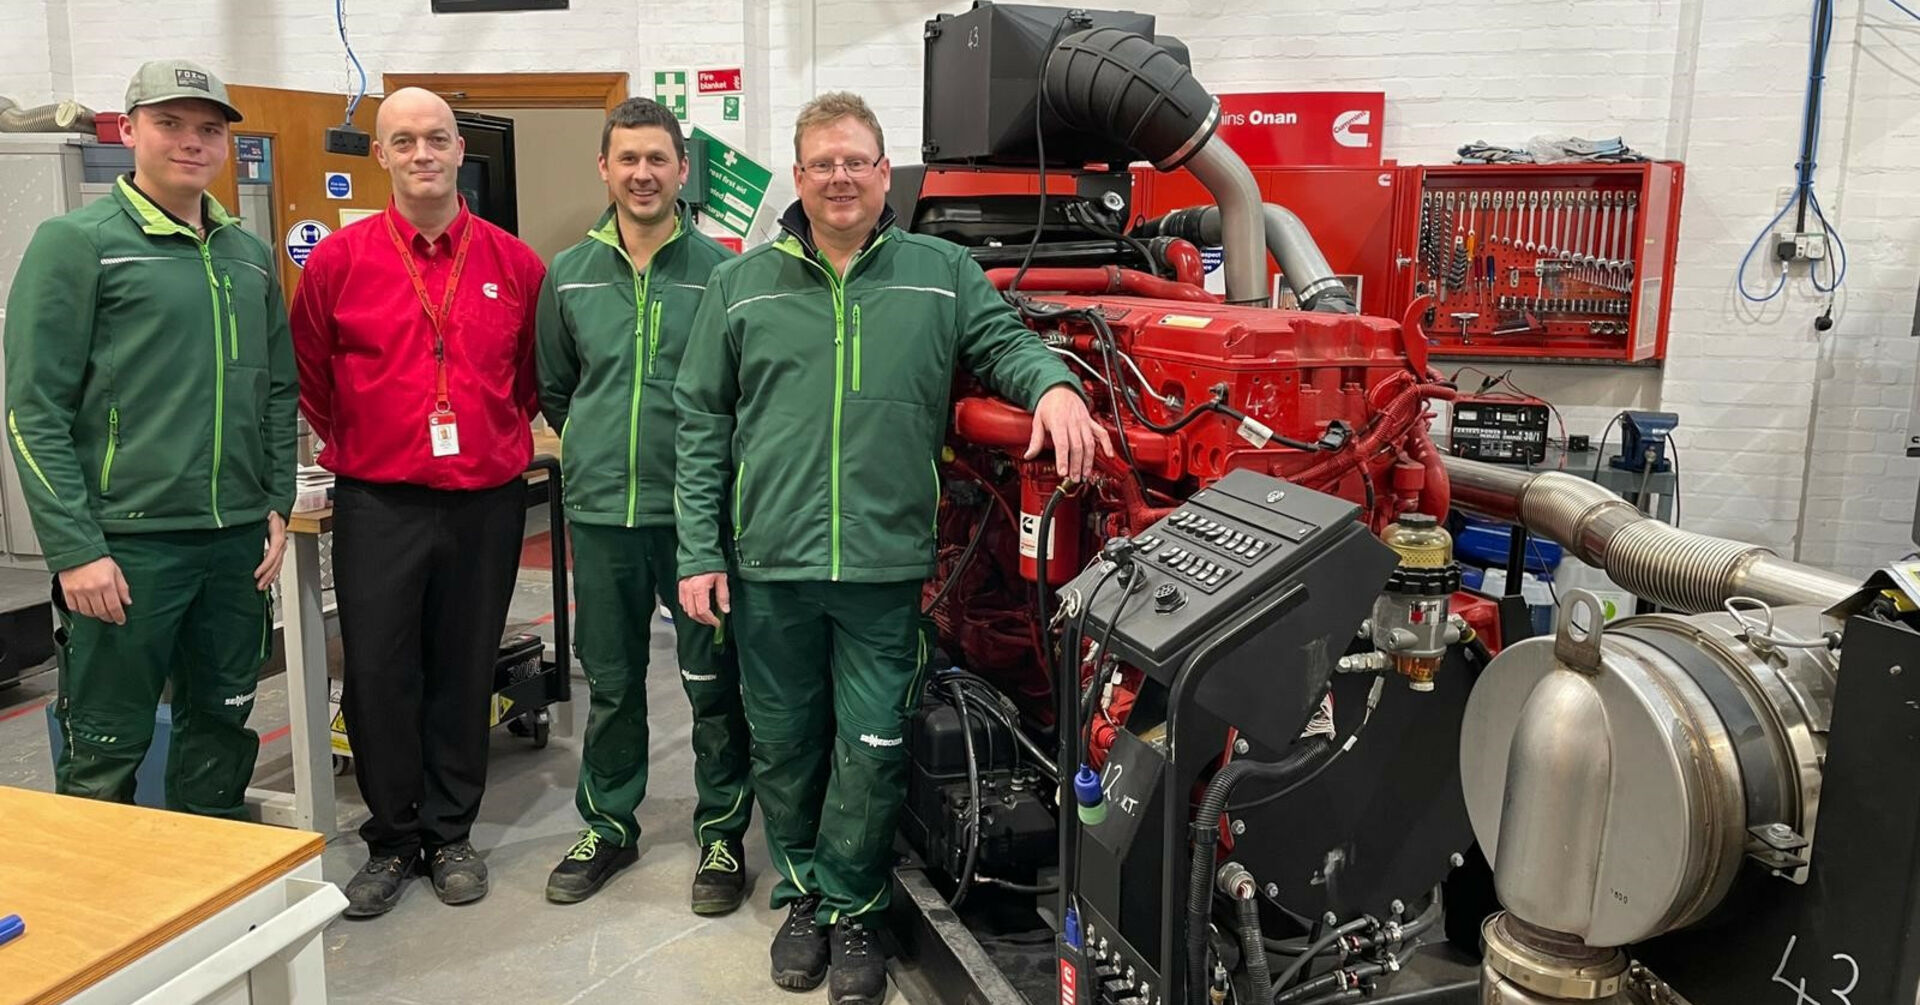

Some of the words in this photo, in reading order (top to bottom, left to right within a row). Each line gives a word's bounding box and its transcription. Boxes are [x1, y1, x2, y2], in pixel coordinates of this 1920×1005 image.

[700, 72, 714, 81] Fire
[700, 81, 727, 90] blanket
[1220, 112, 1245, 126] ins
[1249, 110, 1297, 125] Onan
[1245, 383, 1279, 418] 43
